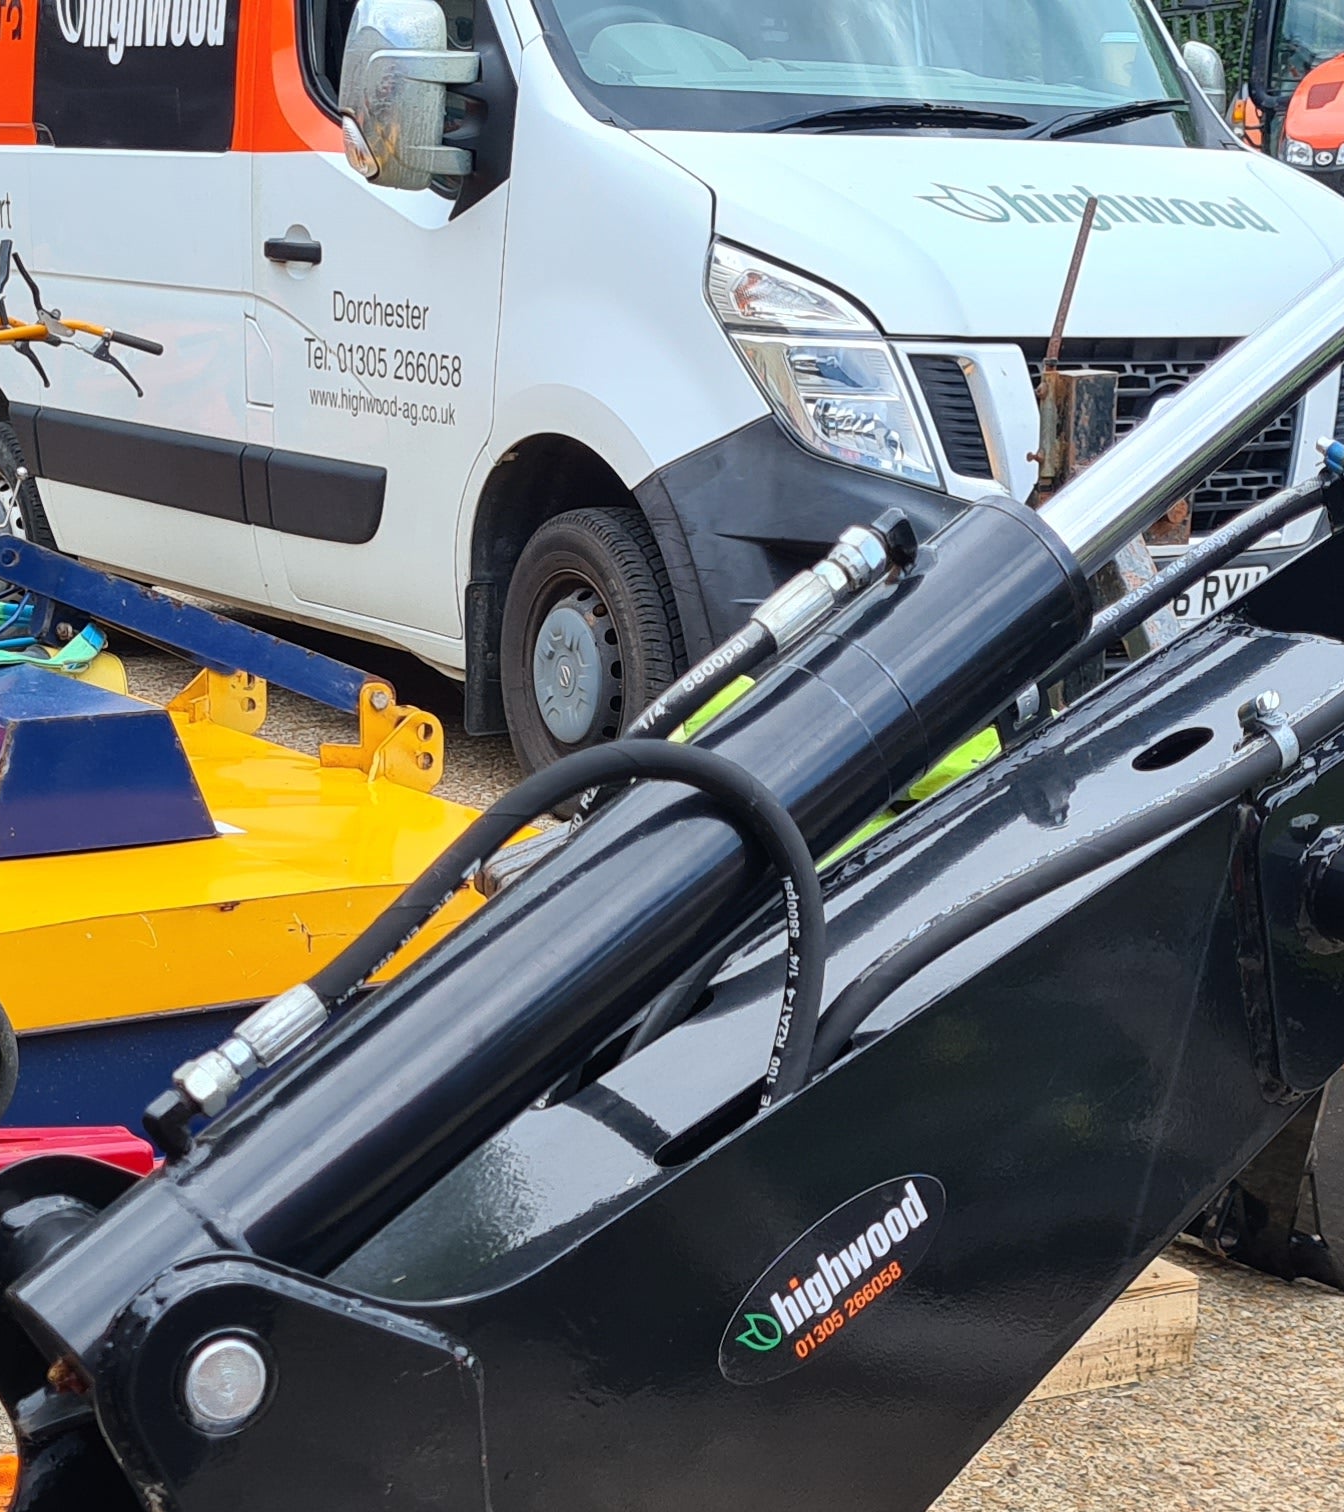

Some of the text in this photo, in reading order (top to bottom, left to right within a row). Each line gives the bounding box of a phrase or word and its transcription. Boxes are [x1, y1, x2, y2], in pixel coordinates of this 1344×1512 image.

[332, 289, 430, 331] Dorchester
[336, 342, 388, 379] 01305
[393, 348, 463, 389] 266058
[308, 387, 457, 427] www.highwood-ag.co.uk
[765, 1055, 782, 1085] 100
[769, 1179, 929, 1336] highwood
[794, 1260, 903, 1359] 01305 266058
